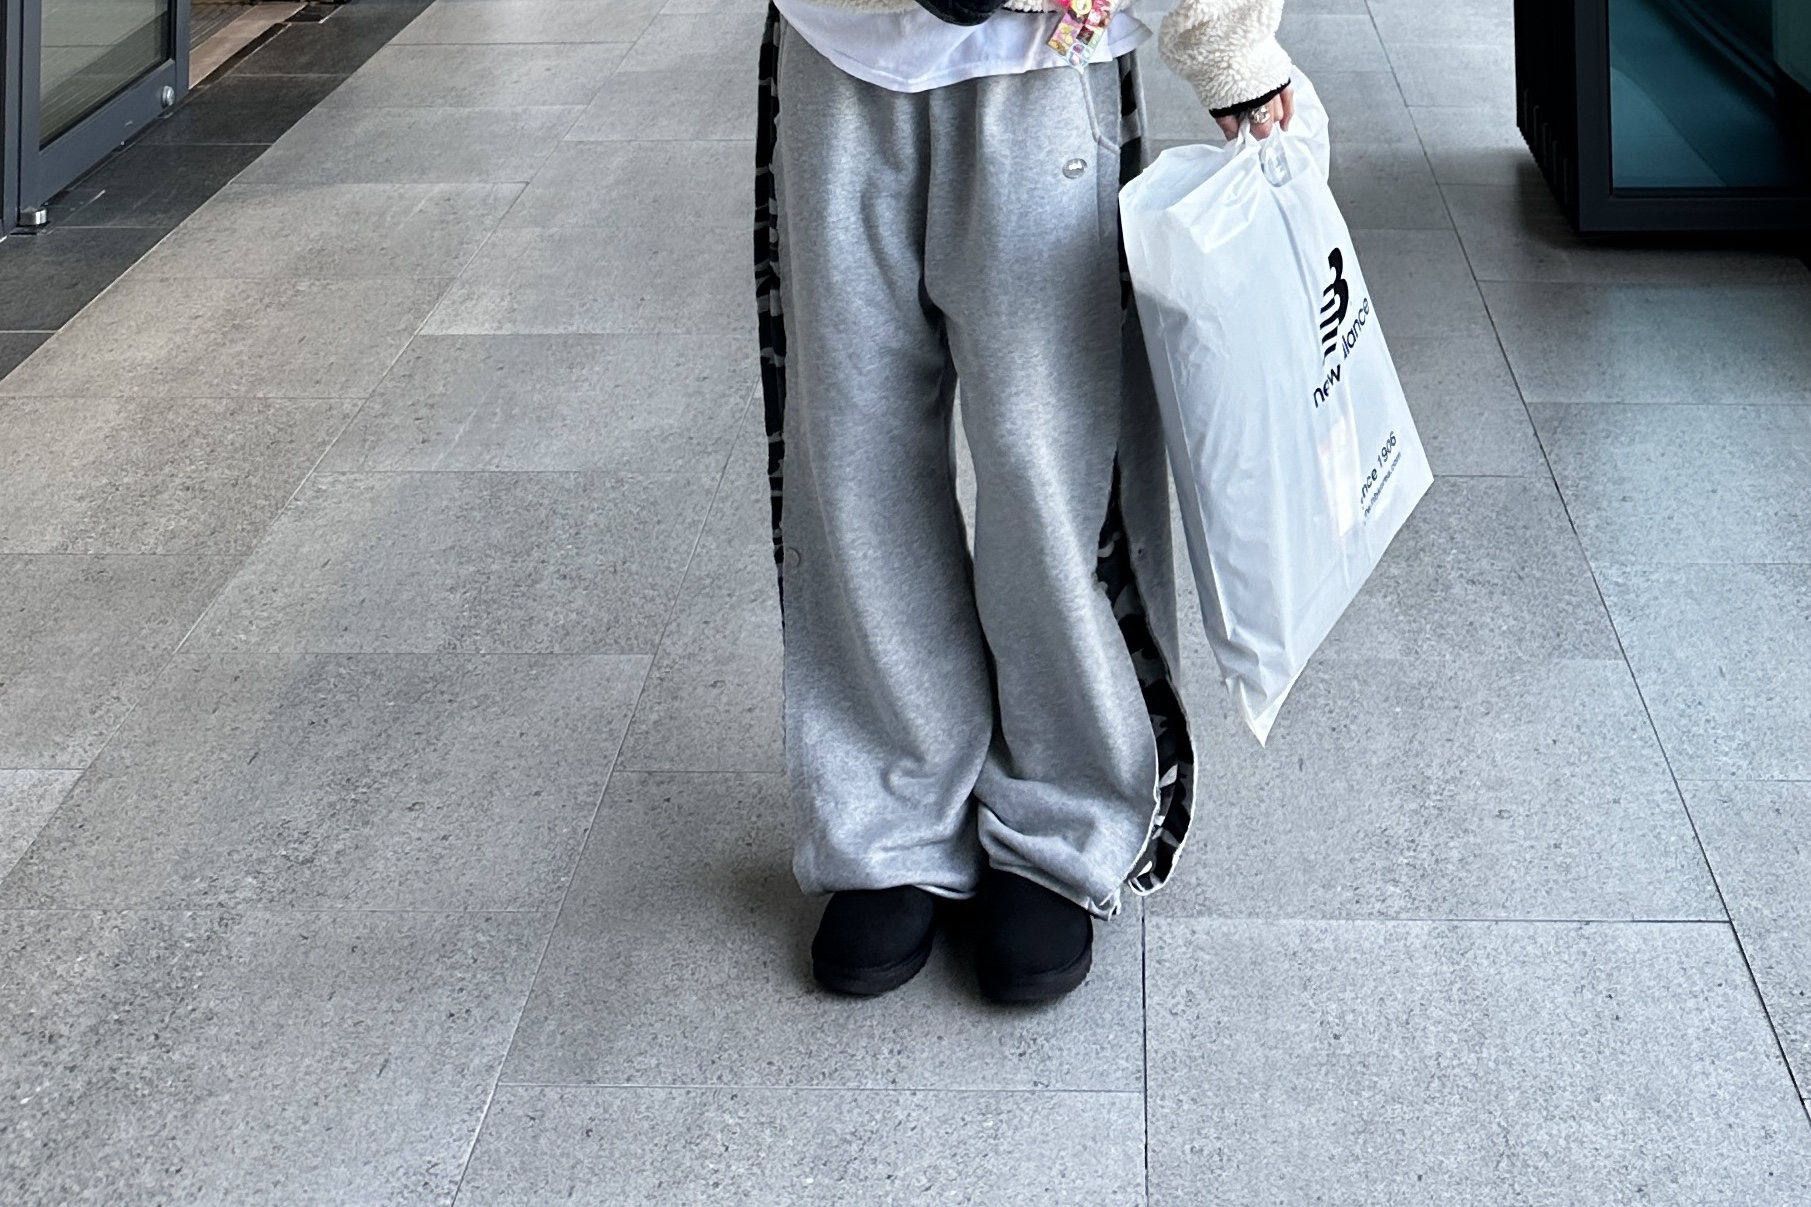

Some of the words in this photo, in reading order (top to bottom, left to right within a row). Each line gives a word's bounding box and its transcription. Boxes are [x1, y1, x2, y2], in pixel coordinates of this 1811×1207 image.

[1313, 364, 1341, 408] new
[1361, 468, 1378, 510] nce
[1378, 430, 1397, 469] 1906
